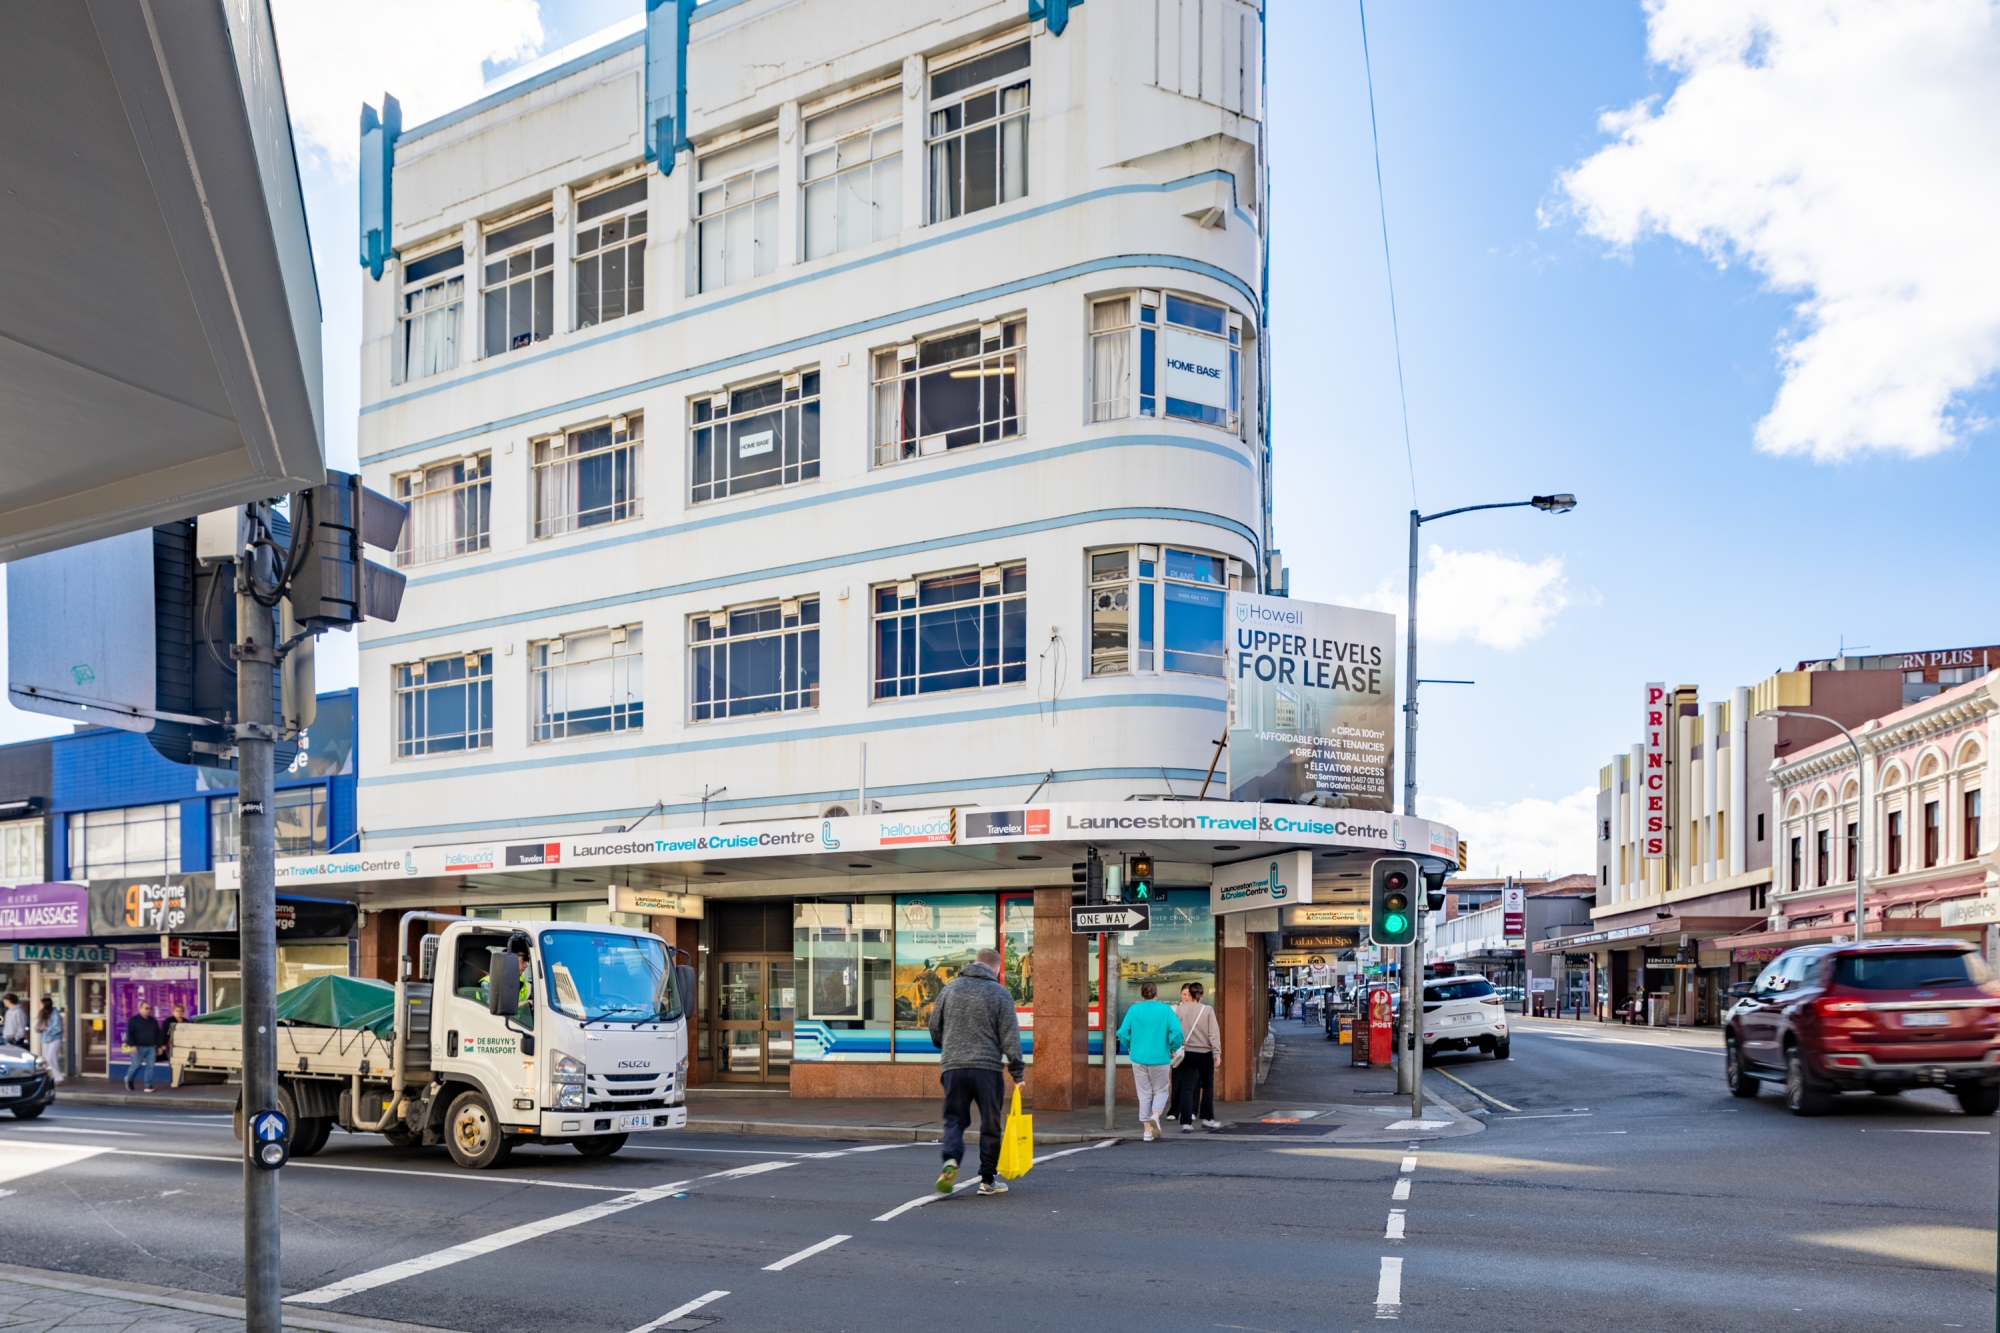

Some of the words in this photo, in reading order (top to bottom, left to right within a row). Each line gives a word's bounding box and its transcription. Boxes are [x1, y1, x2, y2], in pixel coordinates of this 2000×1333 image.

[1168, 358, 1195, 373] HOME
[1196, 365, 1220, 379] BASE
[741, 442, 756, 450] HOME
[1171, 570, 1194, 580] PLANS
[1250, 604, 1302, 624] Howell
[1238, 628, 1306, 656] UPPER
[1313, 638, 1381, 666] LEVELS
[1930, 650, 1973, 666] PLUS
[1239, 652, 1295, 684] FOR
[1304, 660, 1381, 694] LEASE
[1337, 727, 1360, 736] CIRCA
[1260, 732, 1312, 744] AFFORDABLE
[1313, 737, 1341, 747] OFFICE
[1342, 741, 1384, 752] TENANCIES
[1296, 748, 1322, 758] GREAT
[1324, 751, 1360, 762] NATURAL
[1362, 754, 1384, 764] LIGHT
[1310, 762, 1351, 773] ELEVATOR
[1353, 766, 1384, 776] ACCESS
[1648, 688, 1663, 854] PRINCESS
[880, 820, 950, 836] helloworld
[987, 825, 1022, 834] Travelex
[445, 850, 494, 865] helloworld
[8, 894, 38, 904] RITA'S
[25, 906, 78, 925] MASSAGE
[276, 904, 294, 912] ame
[150, 909, 185, 928] Foge
[1080, 915, 1100, 924] ONE
[1106, 914, 1126, 924] WAY
[1335, 937, 1352, 946] Spa
[25, 946, 110, 961] MASSAGE
[186, 950, 209, 958] Forge
[618, 1060, 650, 1068] ISUZU
